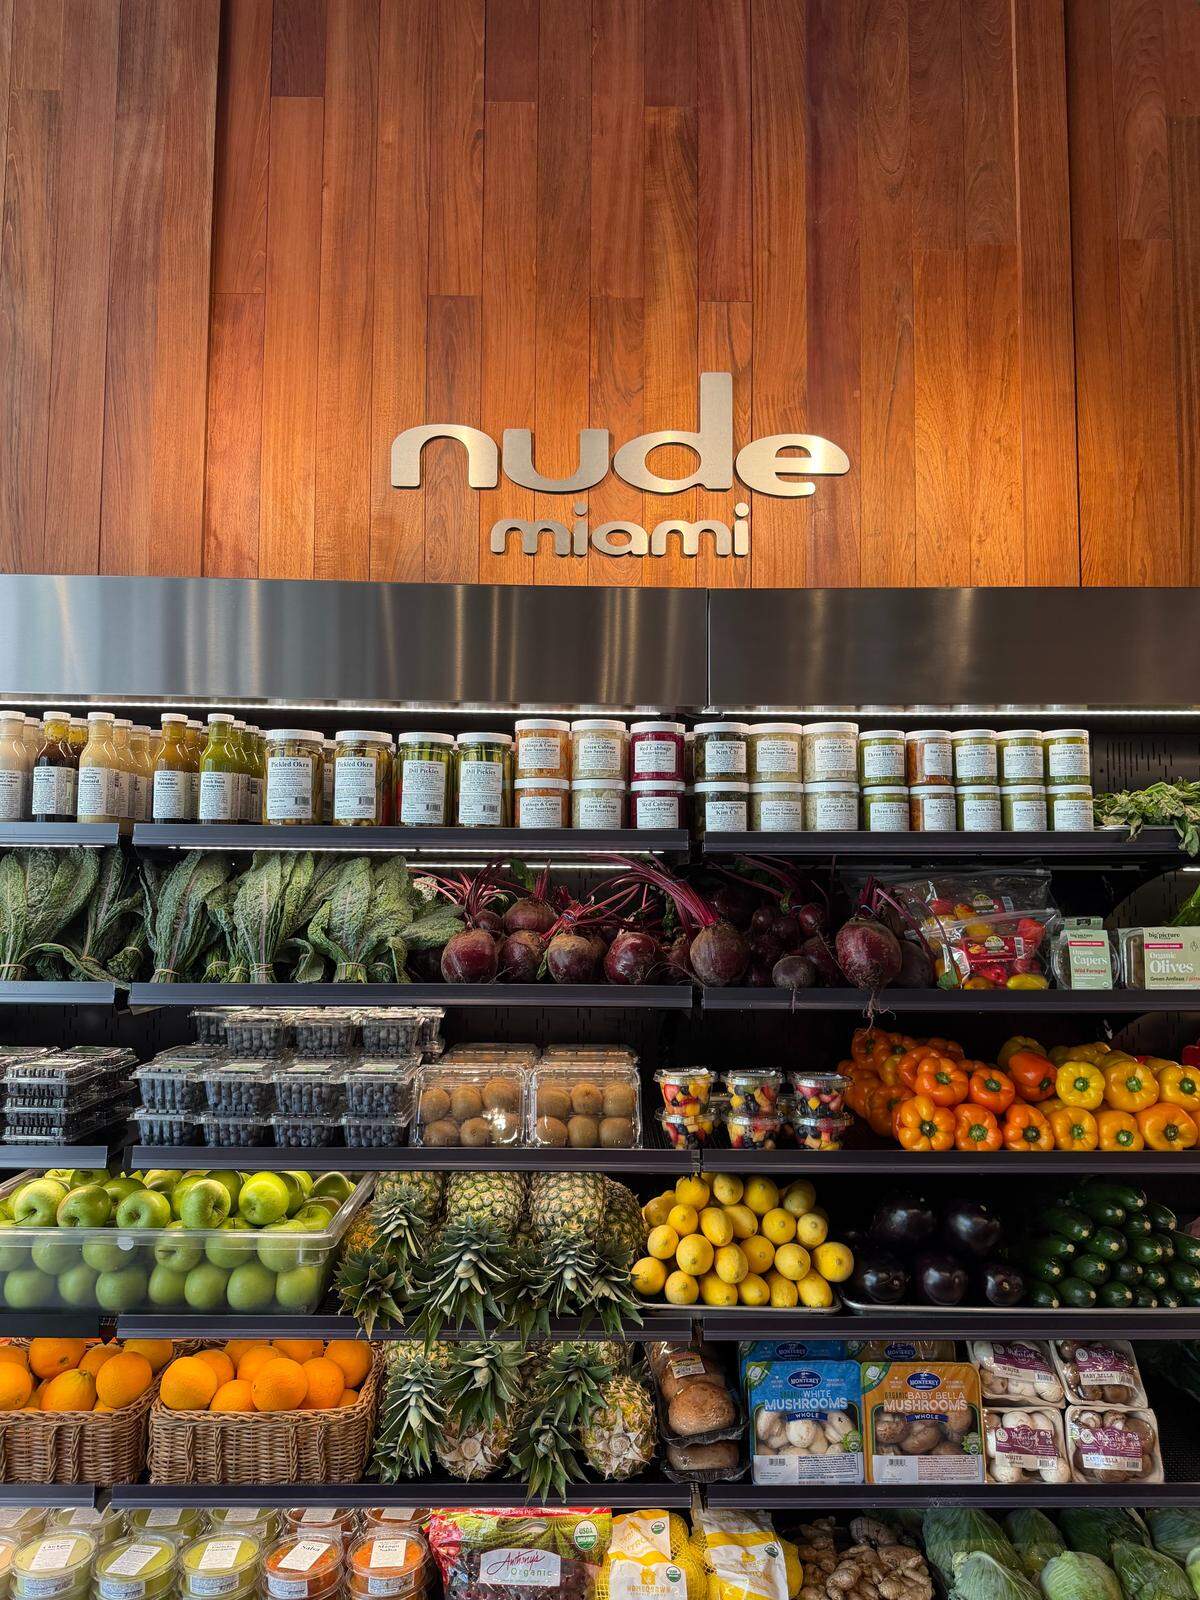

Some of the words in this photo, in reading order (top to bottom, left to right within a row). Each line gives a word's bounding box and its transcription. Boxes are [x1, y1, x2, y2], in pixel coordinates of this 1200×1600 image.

[390, 372, 850, 497] nude
[490, 502, 750, 556] miami
[1072, 955, 1108, 967] Capers
[1149, 952, 1176, 960] Organic
[1149, 959, 1194, 974] Olives
[802, 1389, 832, 1399] WHITE
[907, 1391, 934, 1400] BABY
[936, 1391, 965, 1400] BELLA
[764, 1397, 848, 1412] MUSHROOMS
[883, 1399, 968, 1412] MUSHROOMS
